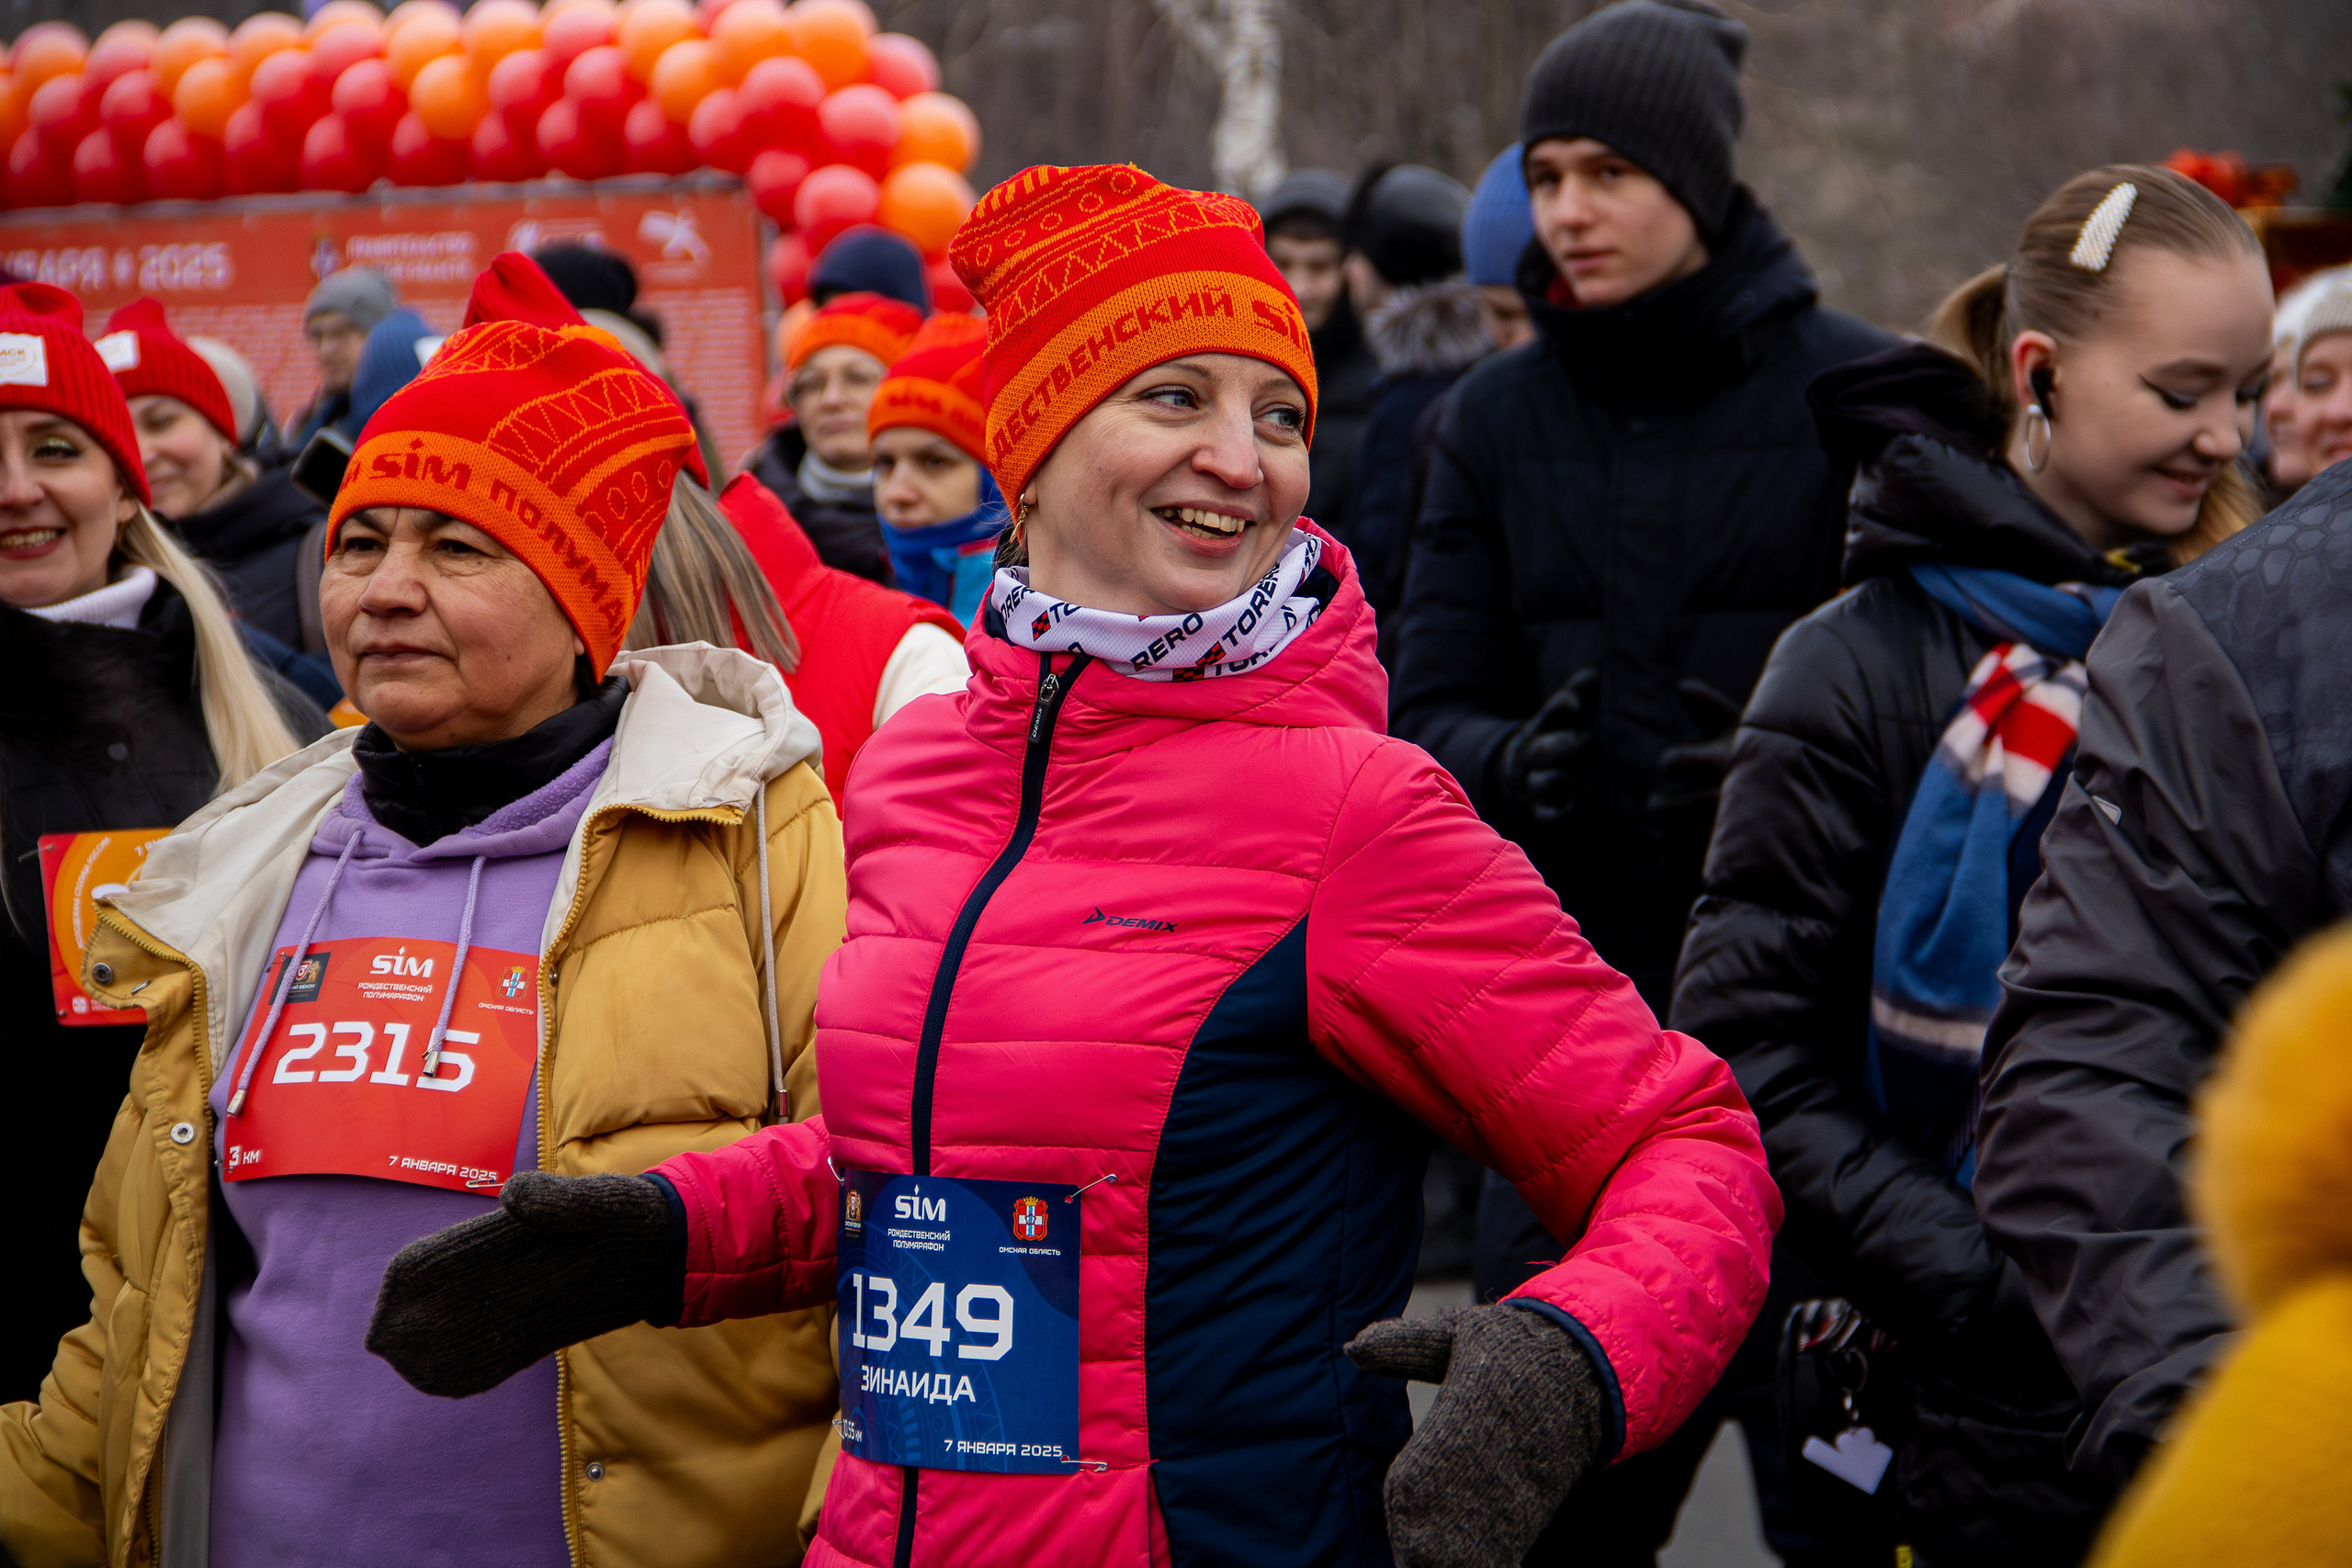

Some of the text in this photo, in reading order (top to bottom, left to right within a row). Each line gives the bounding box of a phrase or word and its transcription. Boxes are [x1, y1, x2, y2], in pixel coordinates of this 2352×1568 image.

[138, 243, 229, 291] 2025
[989, 285, 1234, 473] ДЕСТВЕНСКИЙ
[1032, 705, 1043, 739] DEMIX
[1105, 916, 1178, 932] DEMIX
[357, 982, 433, 994] РОЖДЕСТВЕНСКИЙ
[362, 990, 424, 1002] ПОЛУМАРАФОН
[478, 1002, 534, 1015] ОМСКАЯ ОБЛАСТЬ
[272, 1021, 481, 1093] 2315
[229, 1145, 241, 1167] 3
[389, 1156, 497, 1181] 7 ЯНВАРЯ 2025
[888, 1227, 951, 1242] РОЖДЕСТВЕНСКИЙ
[892, 1239, 944, 1252] ПОЛУМАРАФОН
[999, 1246, 1061, 1257] ОМСКАЯ ОБЛАСТЬ
[852, 1272, 1014, 1361] 1349
[860, 1364, 977, 1406] ЗИНАИДА
[944, 1439, 1062, 1458] 7 ЯНВАРЯ 2025
